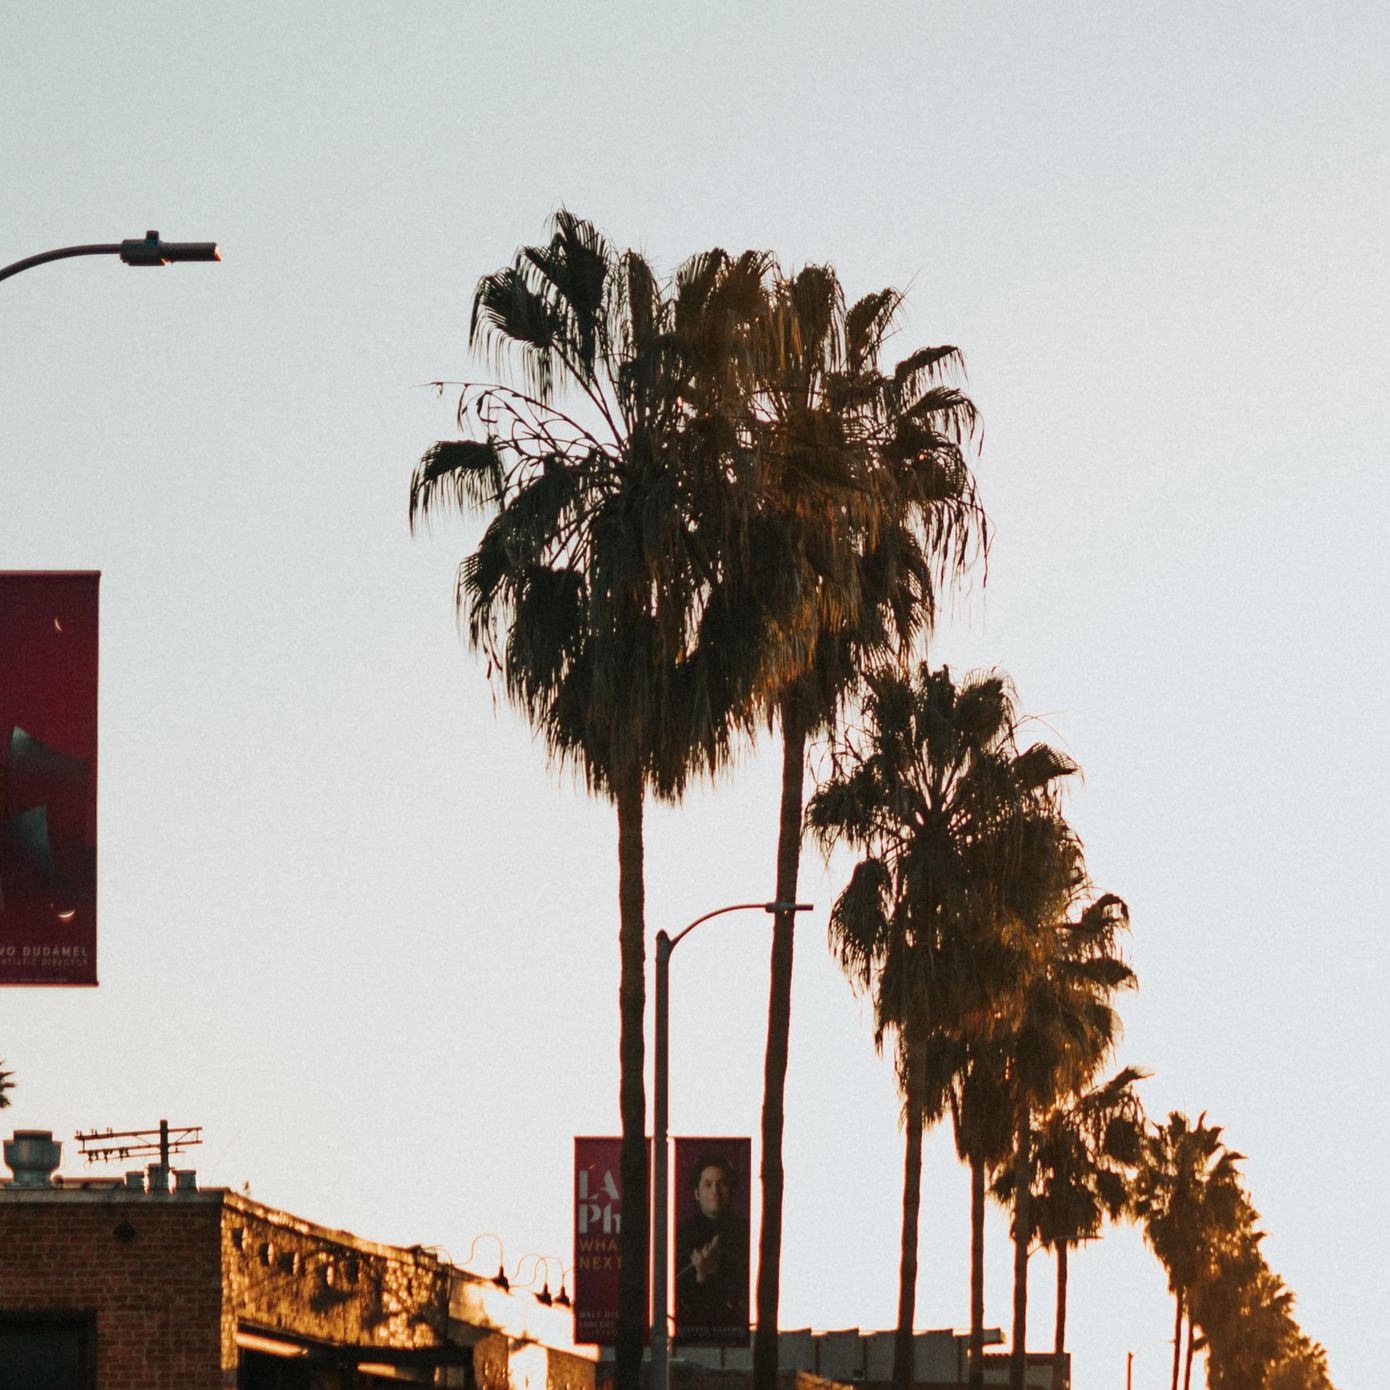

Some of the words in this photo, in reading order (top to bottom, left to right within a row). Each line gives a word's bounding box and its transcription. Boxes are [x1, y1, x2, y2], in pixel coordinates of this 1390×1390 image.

[22, 945, 88, 957] DUDAMEL
[578, 1169, 621, 1201] LA
[578, 1202, 622, 1234] Ph
[579, 1238, 618, 1252] WHA
